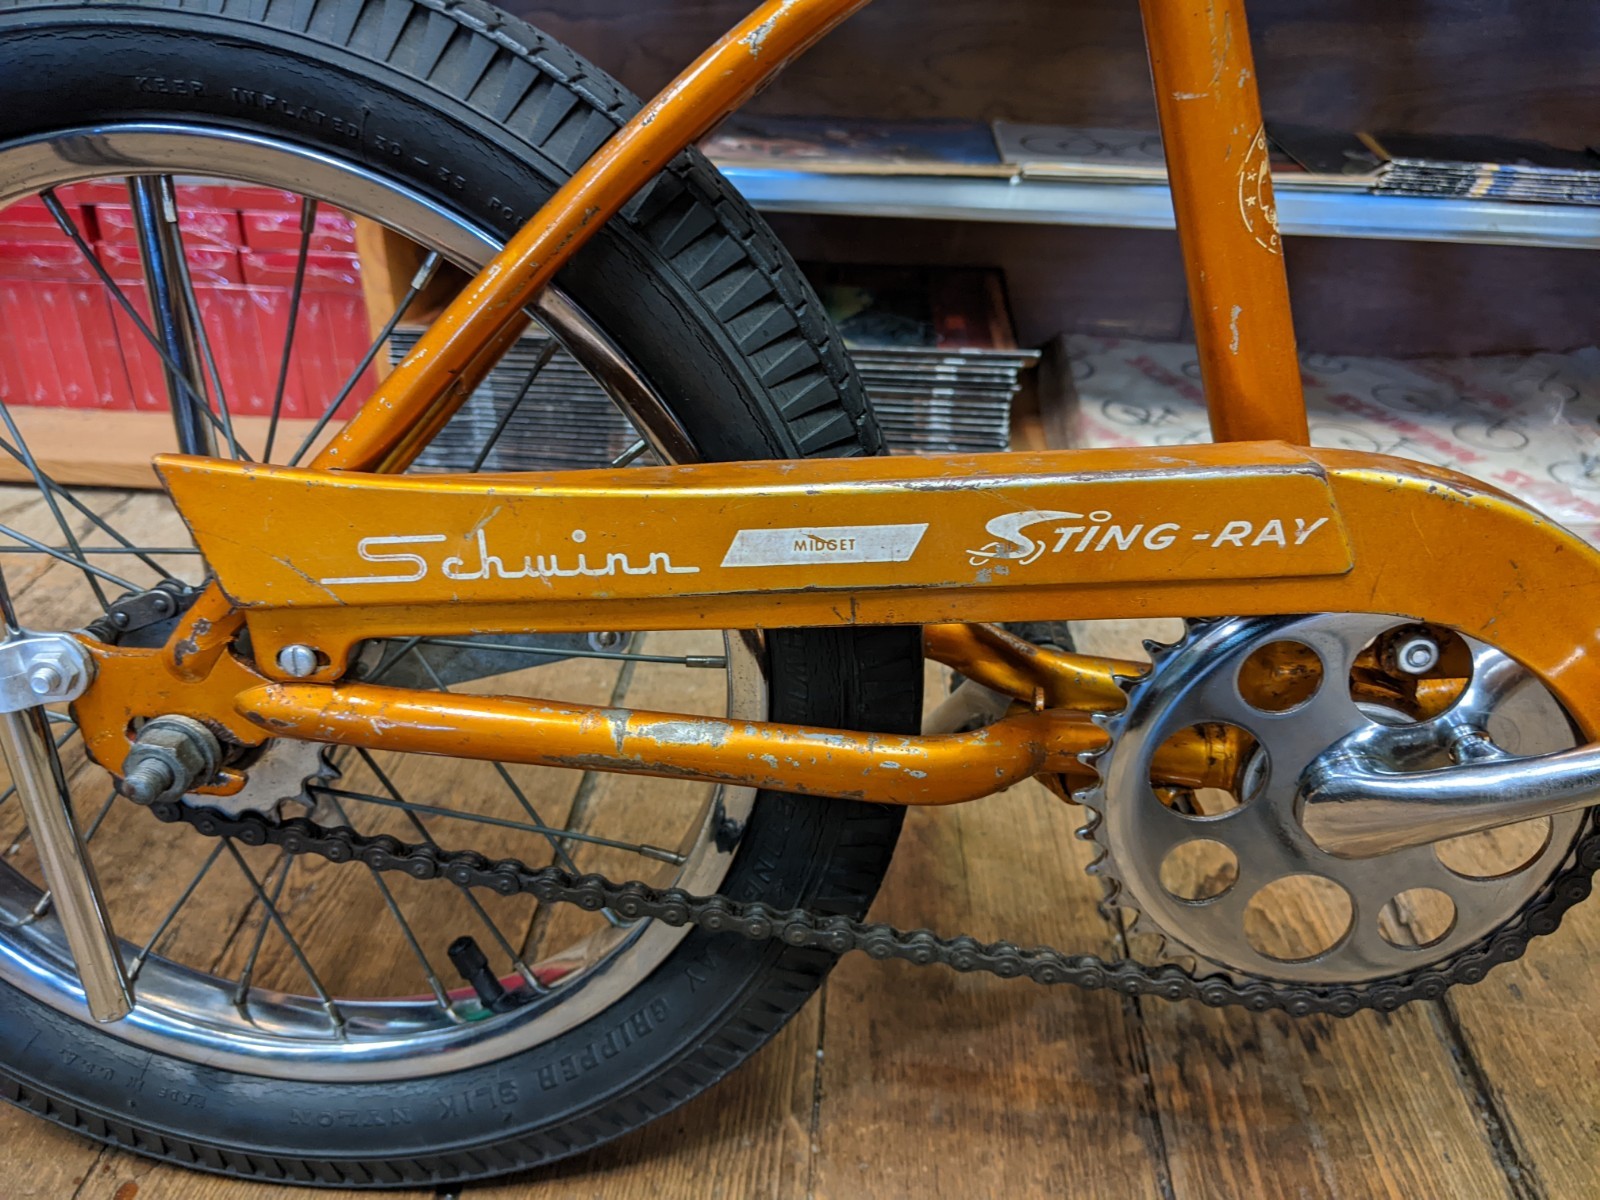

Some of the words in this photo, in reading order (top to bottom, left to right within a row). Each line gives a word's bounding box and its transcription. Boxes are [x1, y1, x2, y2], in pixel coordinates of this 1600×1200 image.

[134, 75, 205, 97] KEEP
[230, 86, 360, 139] INFLATED
[319, 528, 700, 586] Schwinn
[793, 538, 856, 552] MIDGET
[535, 997, 671, 1092] GRIPPER
[287, 1106, 414, 1128] NYLON
[436, 1078, 520, 1121] SLIK
